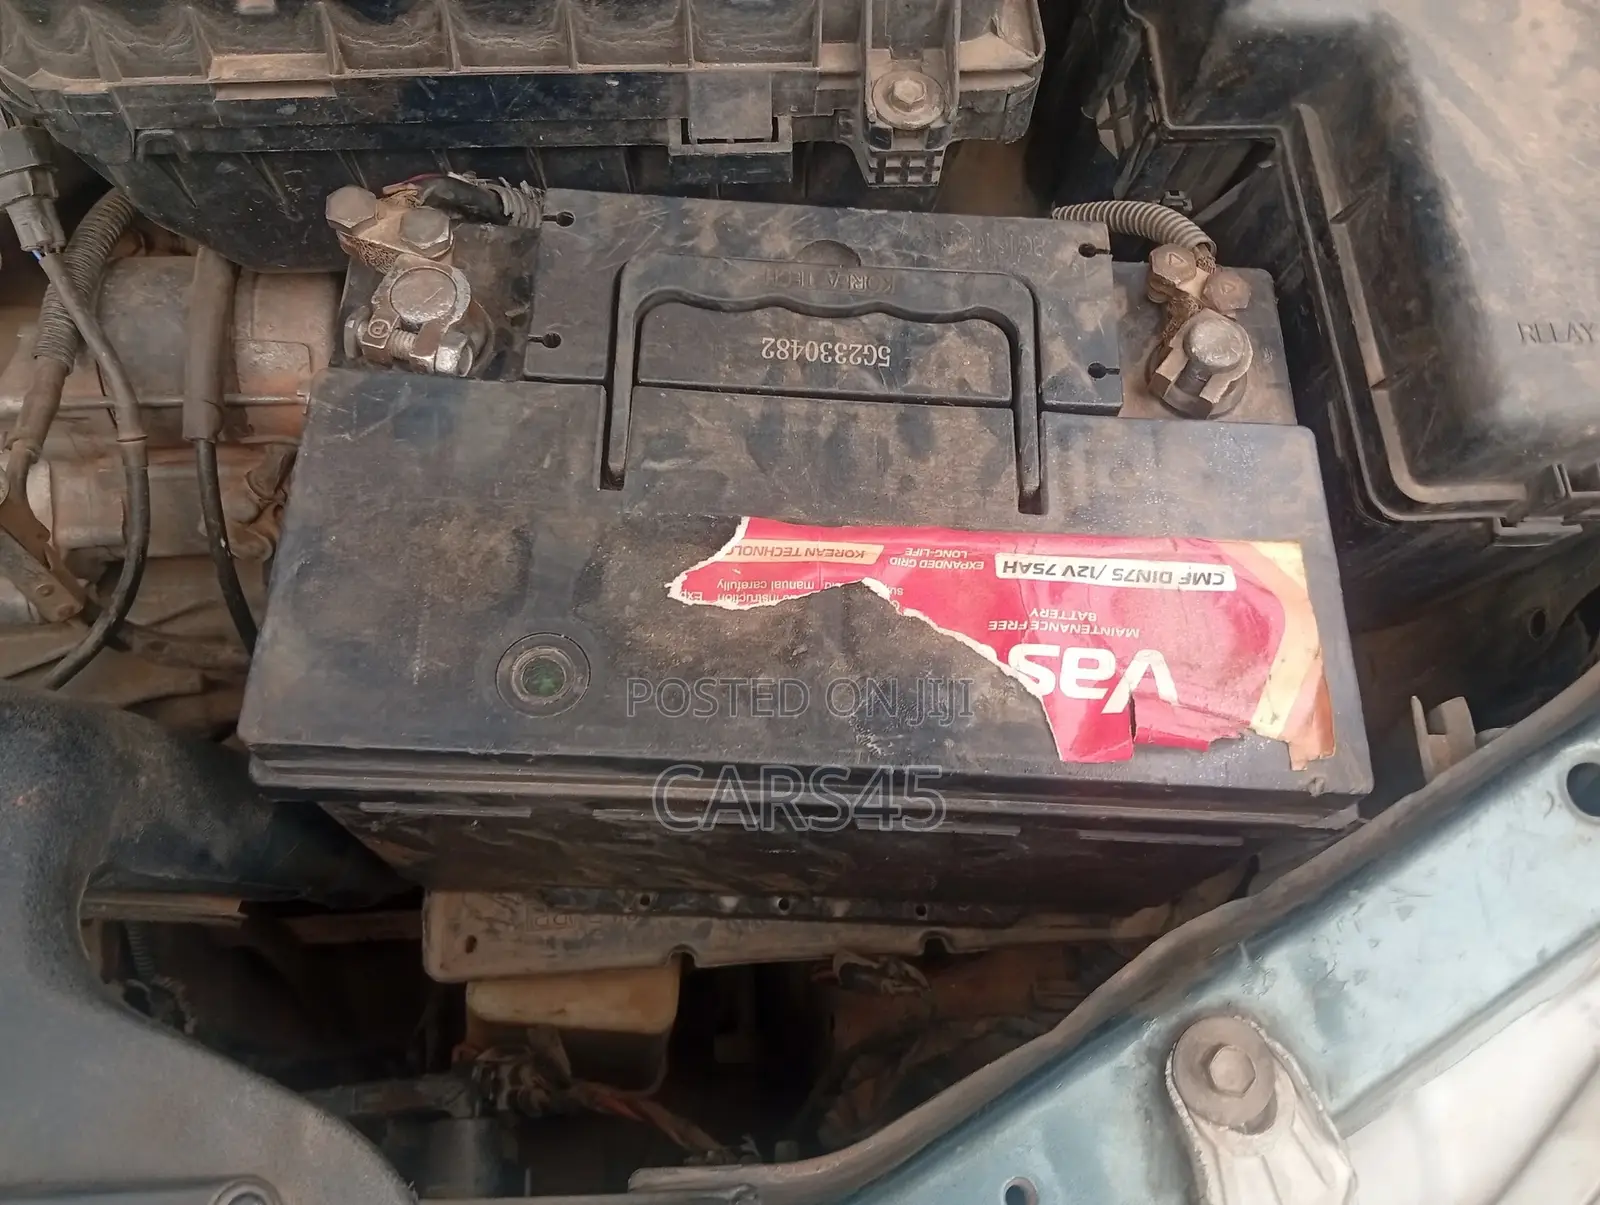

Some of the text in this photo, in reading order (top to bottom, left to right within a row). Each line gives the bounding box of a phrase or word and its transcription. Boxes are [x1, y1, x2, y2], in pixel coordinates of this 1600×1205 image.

[761, 337, 892, 368] 5G2330482
[805, 547, 866, 560] KOREAN
[904, 547, 968, 559] LONG-LIFE
[889, 557, 985, 570] EXPANDED GRID
[1002, 560, 1057, 576] 75AH
[716, 578, 768, 590] carefully
[1111, 568, 1173, 585] DIN75
[1177, 571, 1225, 587] CMF
[771, 579, 815, 590] manual
[1028, 607, 1097, 622] BATTERY
[987, 620, 1140, 638] MAINTENANCE FREE
